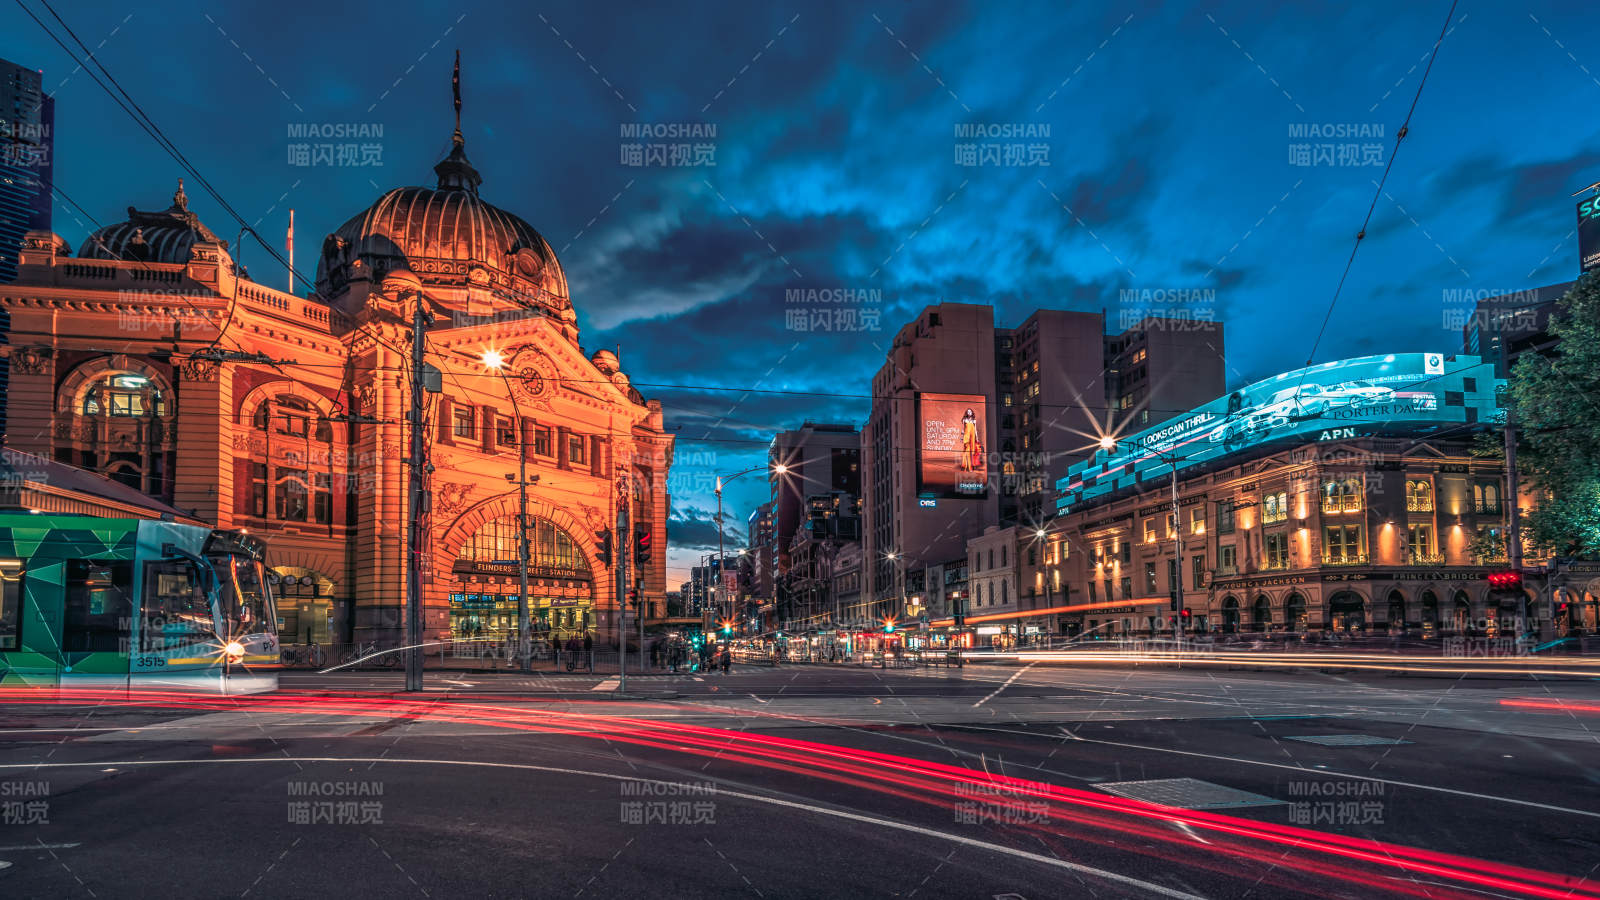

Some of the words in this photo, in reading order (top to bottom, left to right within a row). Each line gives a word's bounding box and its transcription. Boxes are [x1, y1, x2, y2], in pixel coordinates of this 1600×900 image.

[1333, 406, 1390, 420] PORTER
[1143, 429, 1168, 446] LOOKS
[1167, 421, 1185, 436] CAN
[1185, 411, 1216, 430] THRILL.
[1320, 427, 1355, 441] APN
[477, 563, 513, 573] FLINDERS
[549, 568, 577, 577] STATION
[1442, 573, 1481, 581] BRIDGE
[1225, 580, 1254, 589] YOUNG
[1263, 576, 1305, 587] JACKSON
[137, 657, 165, 667] 3515
